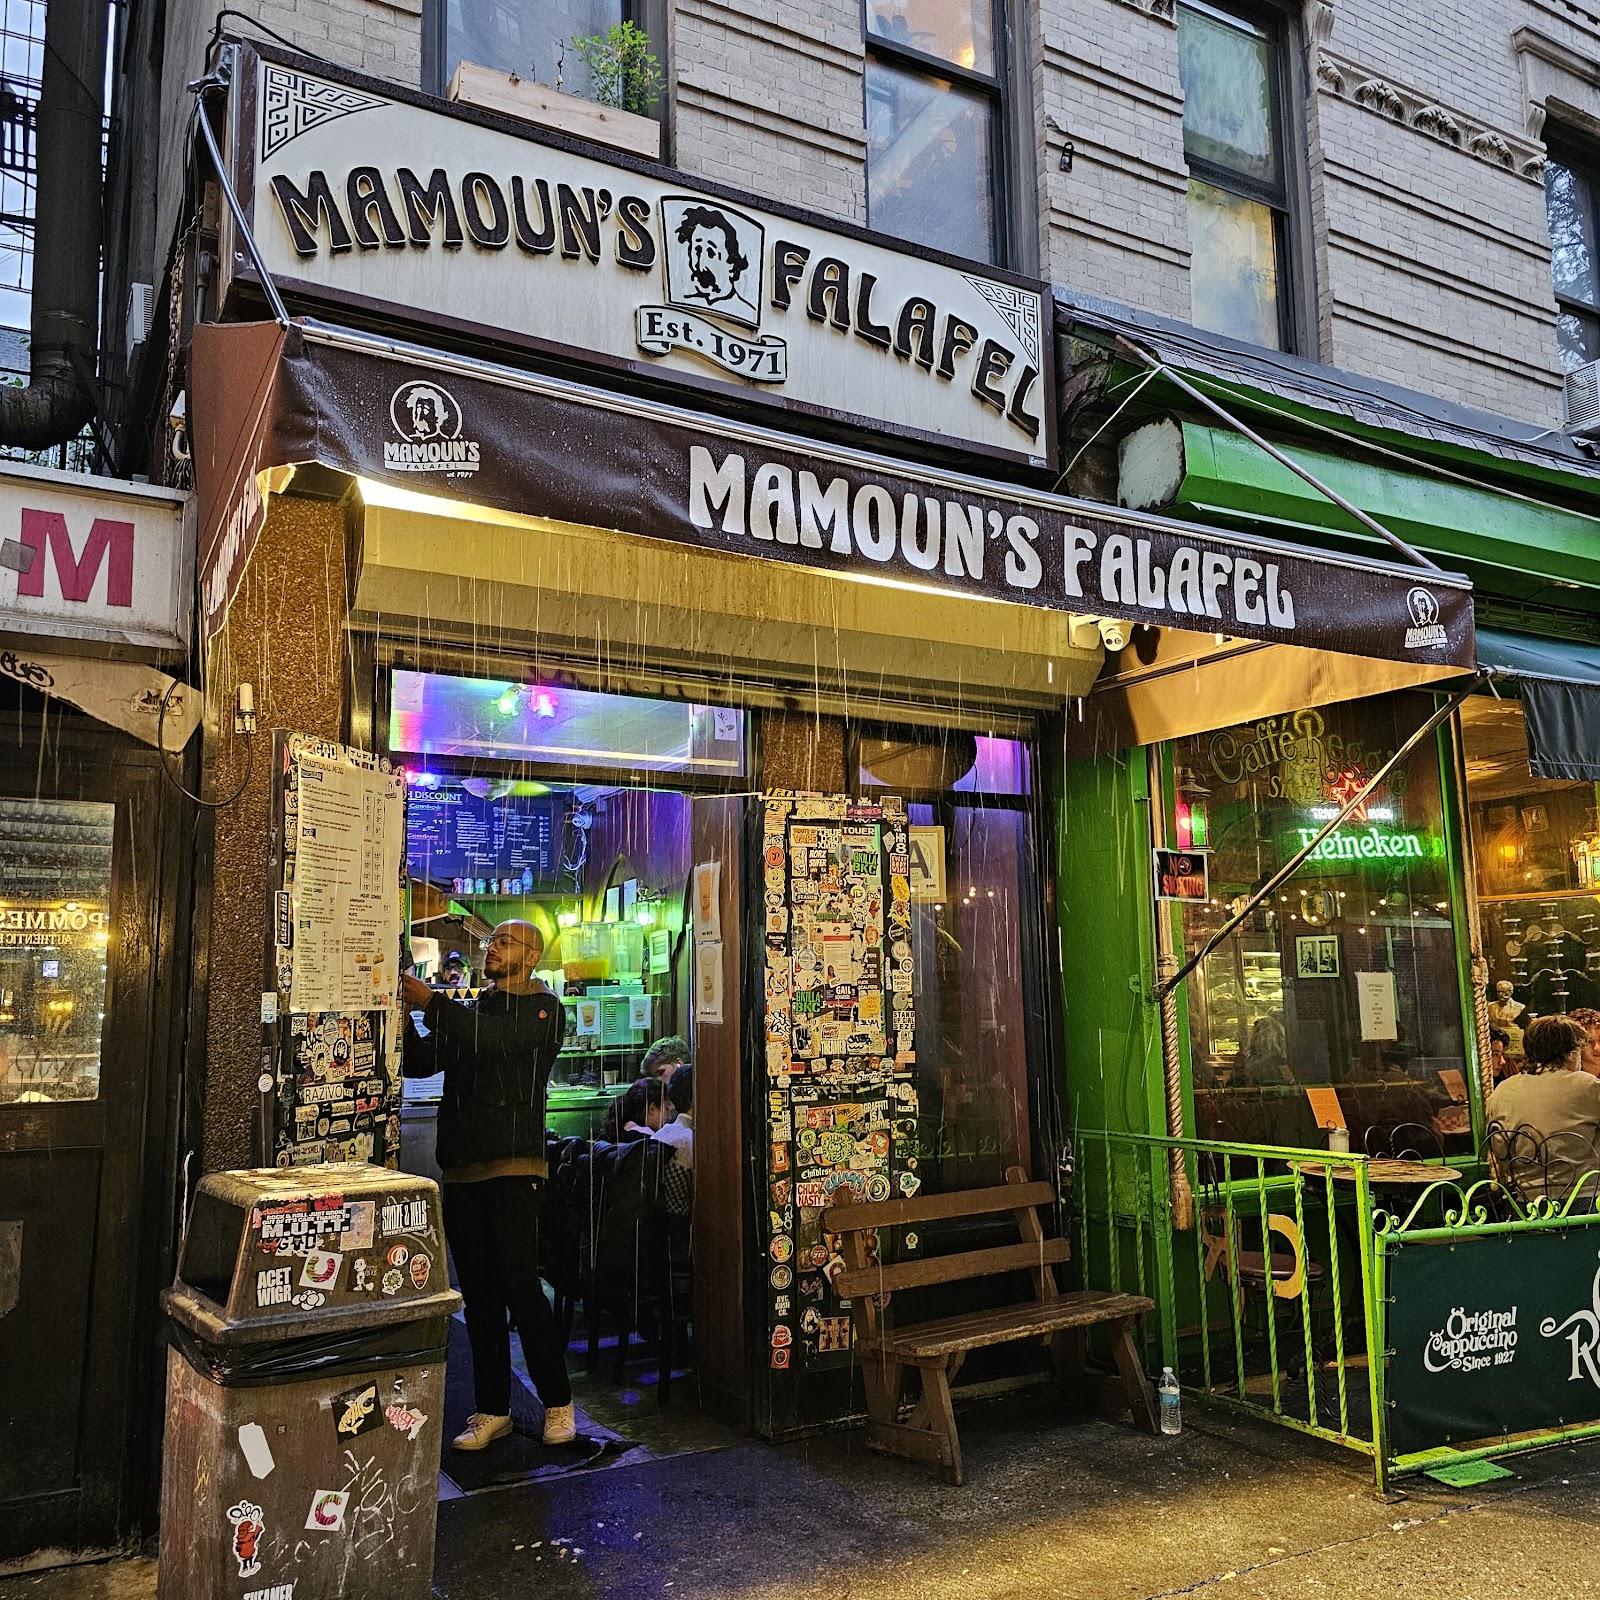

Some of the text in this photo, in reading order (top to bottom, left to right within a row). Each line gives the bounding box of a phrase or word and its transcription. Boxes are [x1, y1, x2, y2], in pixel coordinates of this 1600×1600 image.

[270, 166, 1040, 438] MAMOUN'S FALAFEL
[646, 312, 783, 376] Est. 1971
[383, 441, 480, 463] MAMOUN'S
[406, 462, 460, 470] FALAFEL
[689, 445, 1296, 630] MAMOUN'S FALAFEL
[17, 508, 135, 608] M
[1405, 624, 1447, 642] MAMOUN'S
[414, 791, 462, 801] DISCOUNT
[793, 833, 817, 845] VAPE
[842, 826, 875, 836] TOUER
[895, 832, 907, 844] HR
[1298, 827, 1424, 860] Heineken
[910, 840, 932, 879] A
[852, 862, 877, 876] BKC
[1162, 874, 1204, 897] SMOKING
[836, 985, 851, 995] GAIL
[795, 1002, 821, 1012] BKC
[305, 1084, 343, 1101] RAZIVO
[863, 1100, 888, 1113] GRAFFITI
[869, 1111, 878, 1121] IS
[798, 1194, 822, 1206] NASTY
[261, 1219, 349, 1238] M.U.T.T.
[1446, 1306, 1518, 1340] Original
[1423, 1328, 1518, 1373] Cappuccino
[1461, 1349, 1516, 1373] Since 1927
